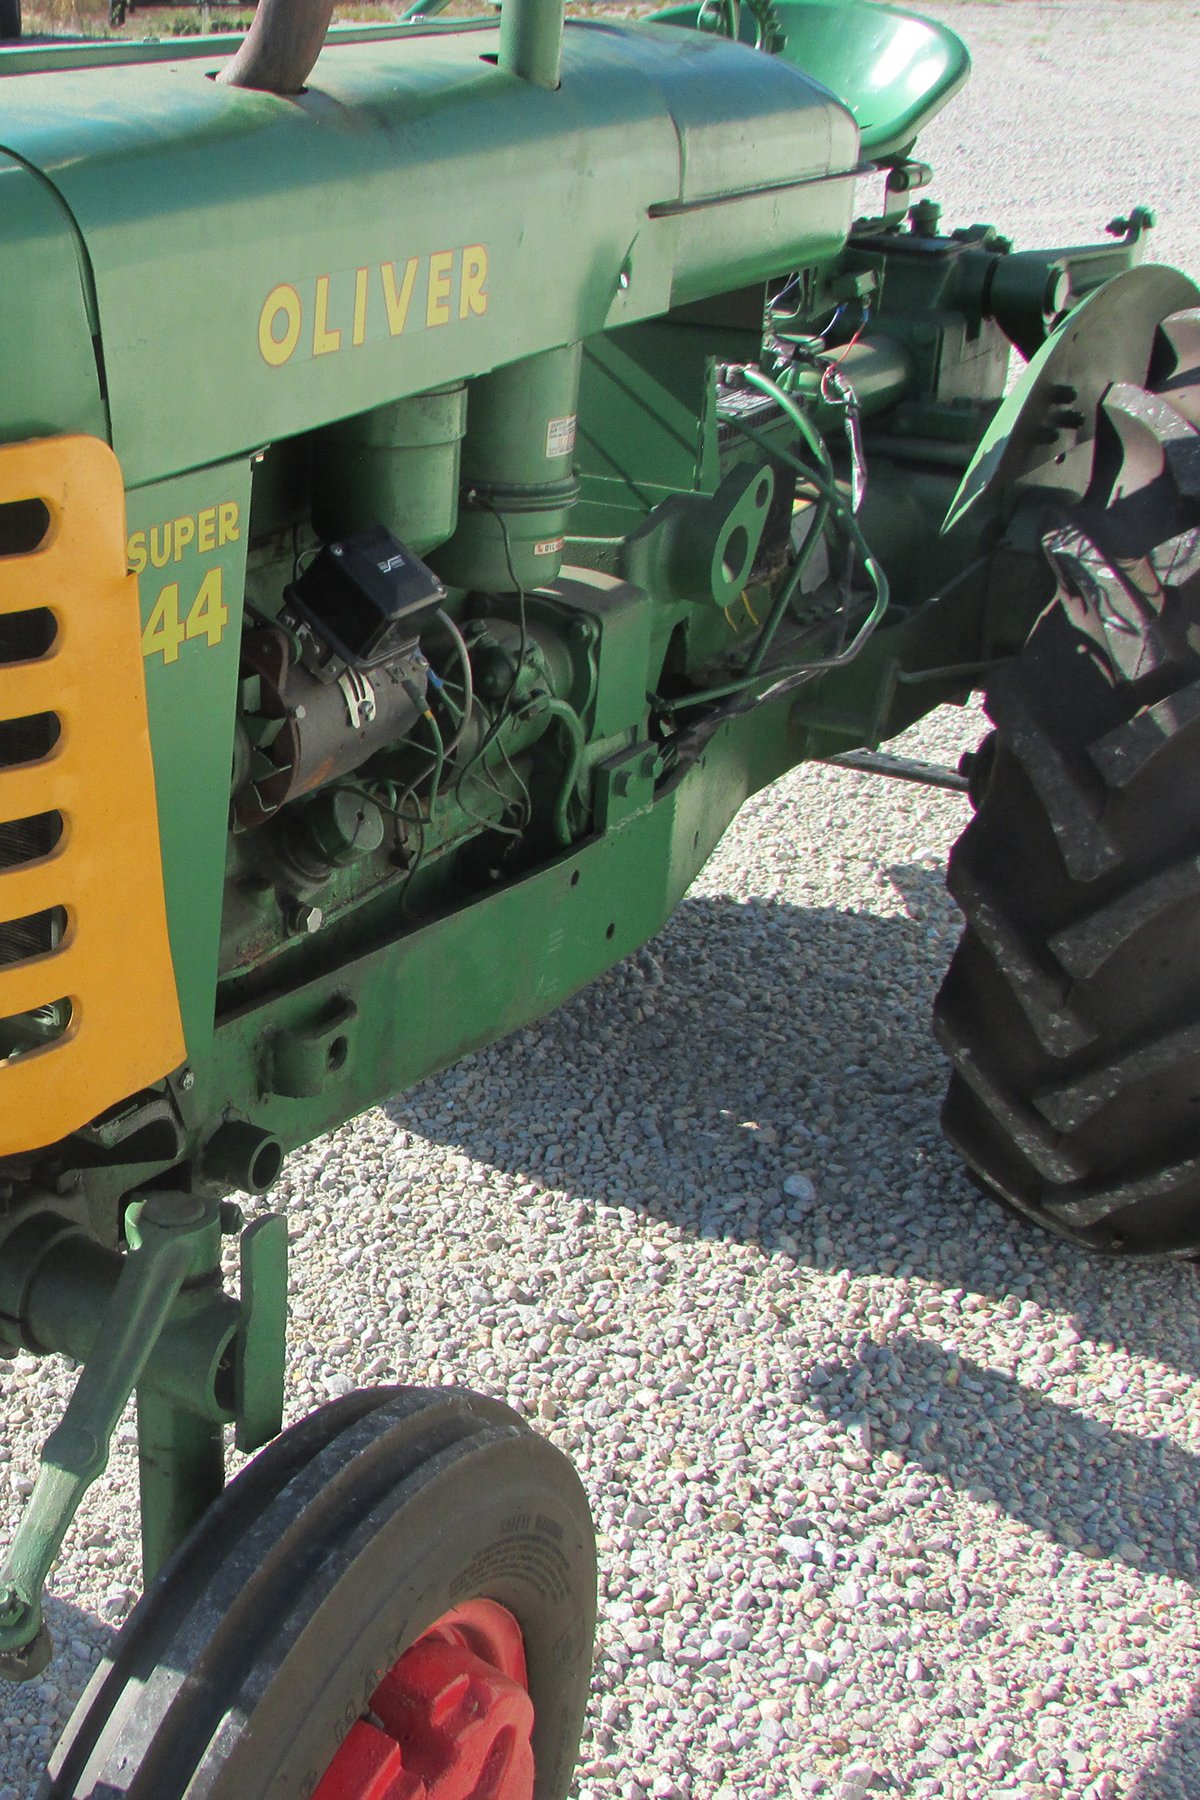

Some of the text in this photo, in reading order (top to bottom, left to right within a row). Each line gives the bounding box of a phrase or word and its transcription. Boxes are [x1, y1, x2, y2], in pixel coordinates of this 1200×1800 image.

[258, 243, 488, 367] OLIVER
[127, 501, 240, 575] SUPER
[141, 566, 228, 665] 44
